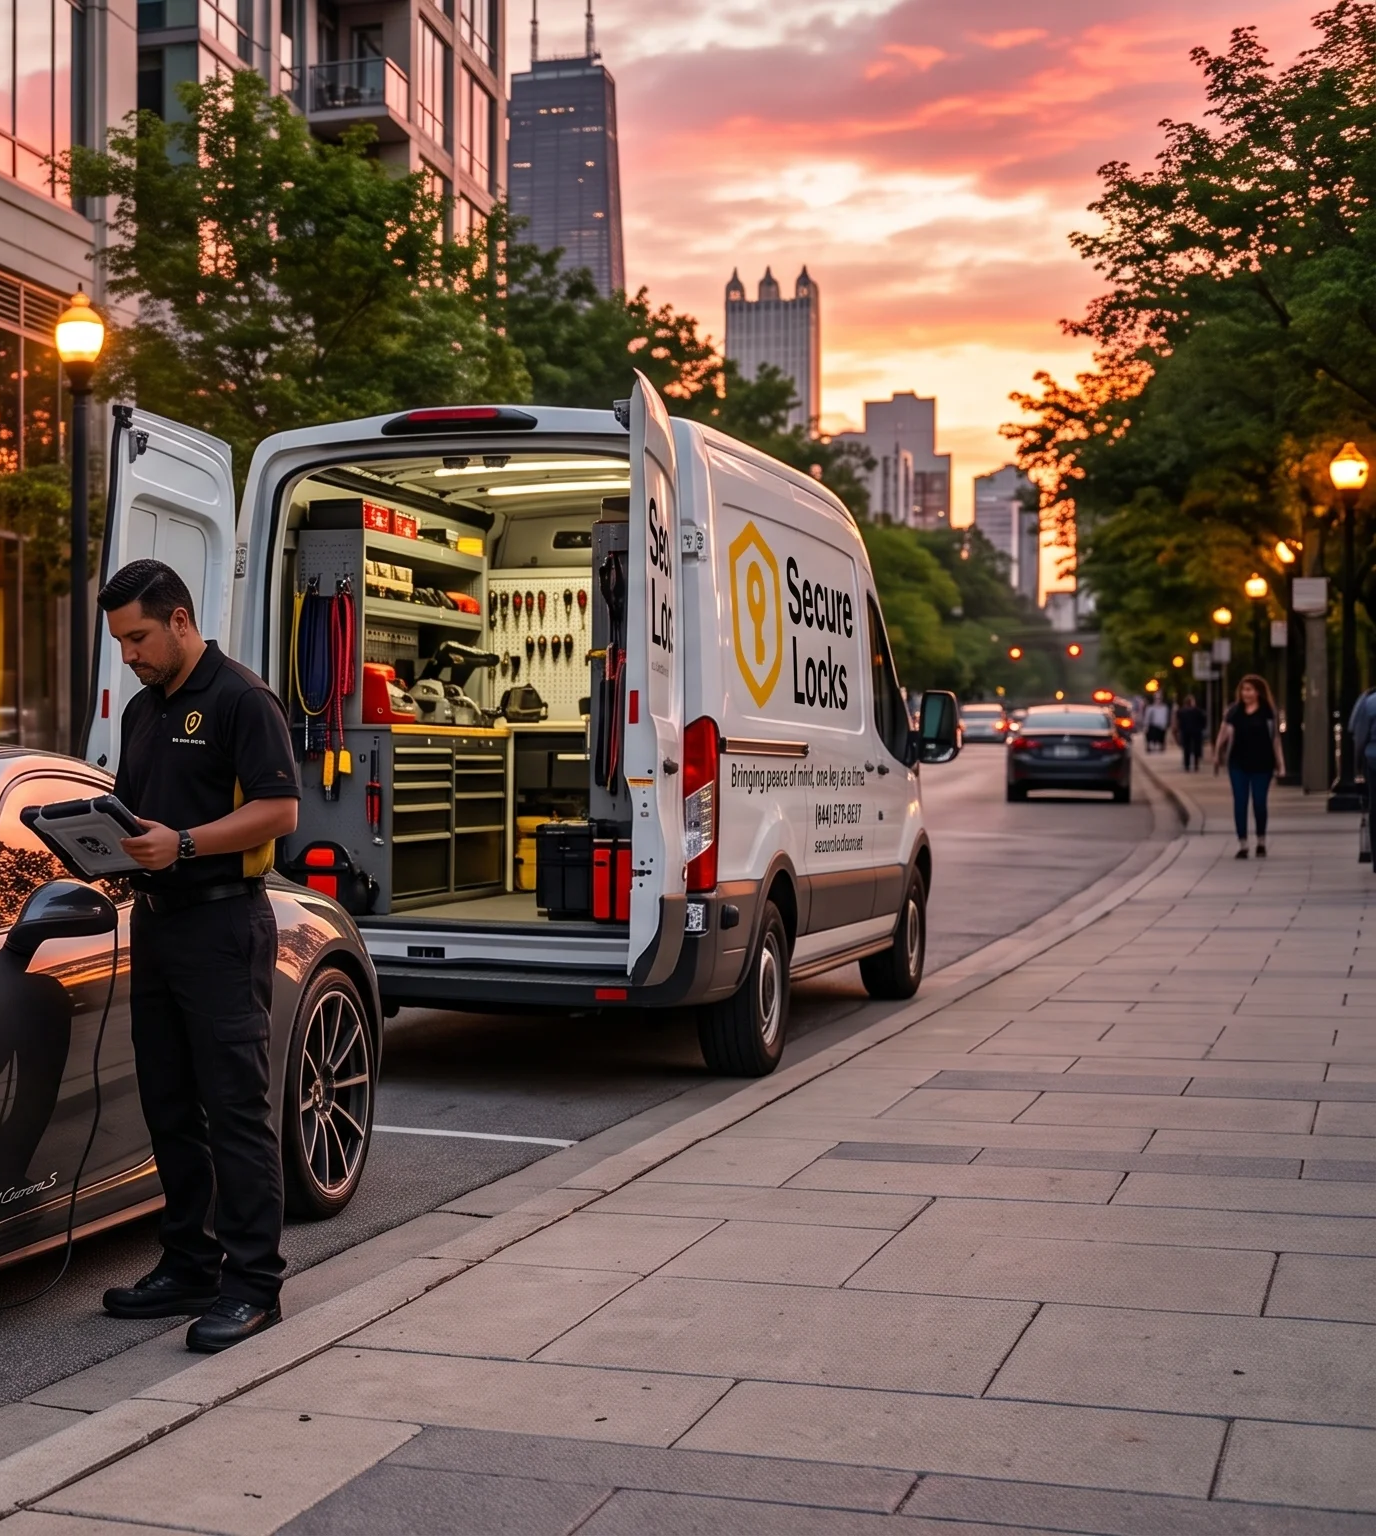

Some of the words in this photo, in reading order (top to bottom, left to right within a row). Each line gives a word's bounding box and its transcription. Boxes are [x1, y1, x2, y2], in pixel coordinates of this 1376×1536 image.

[786, 556, 853, 639] Secure
[792, 636, 848, 711] Locks
[731, 763, 765, 794] Bringing
[766, 769, 788, 793] peace
[789, 763, 797, 787] of
[816, 769, 828, 787] one
[829, 764, 839, 791] key
